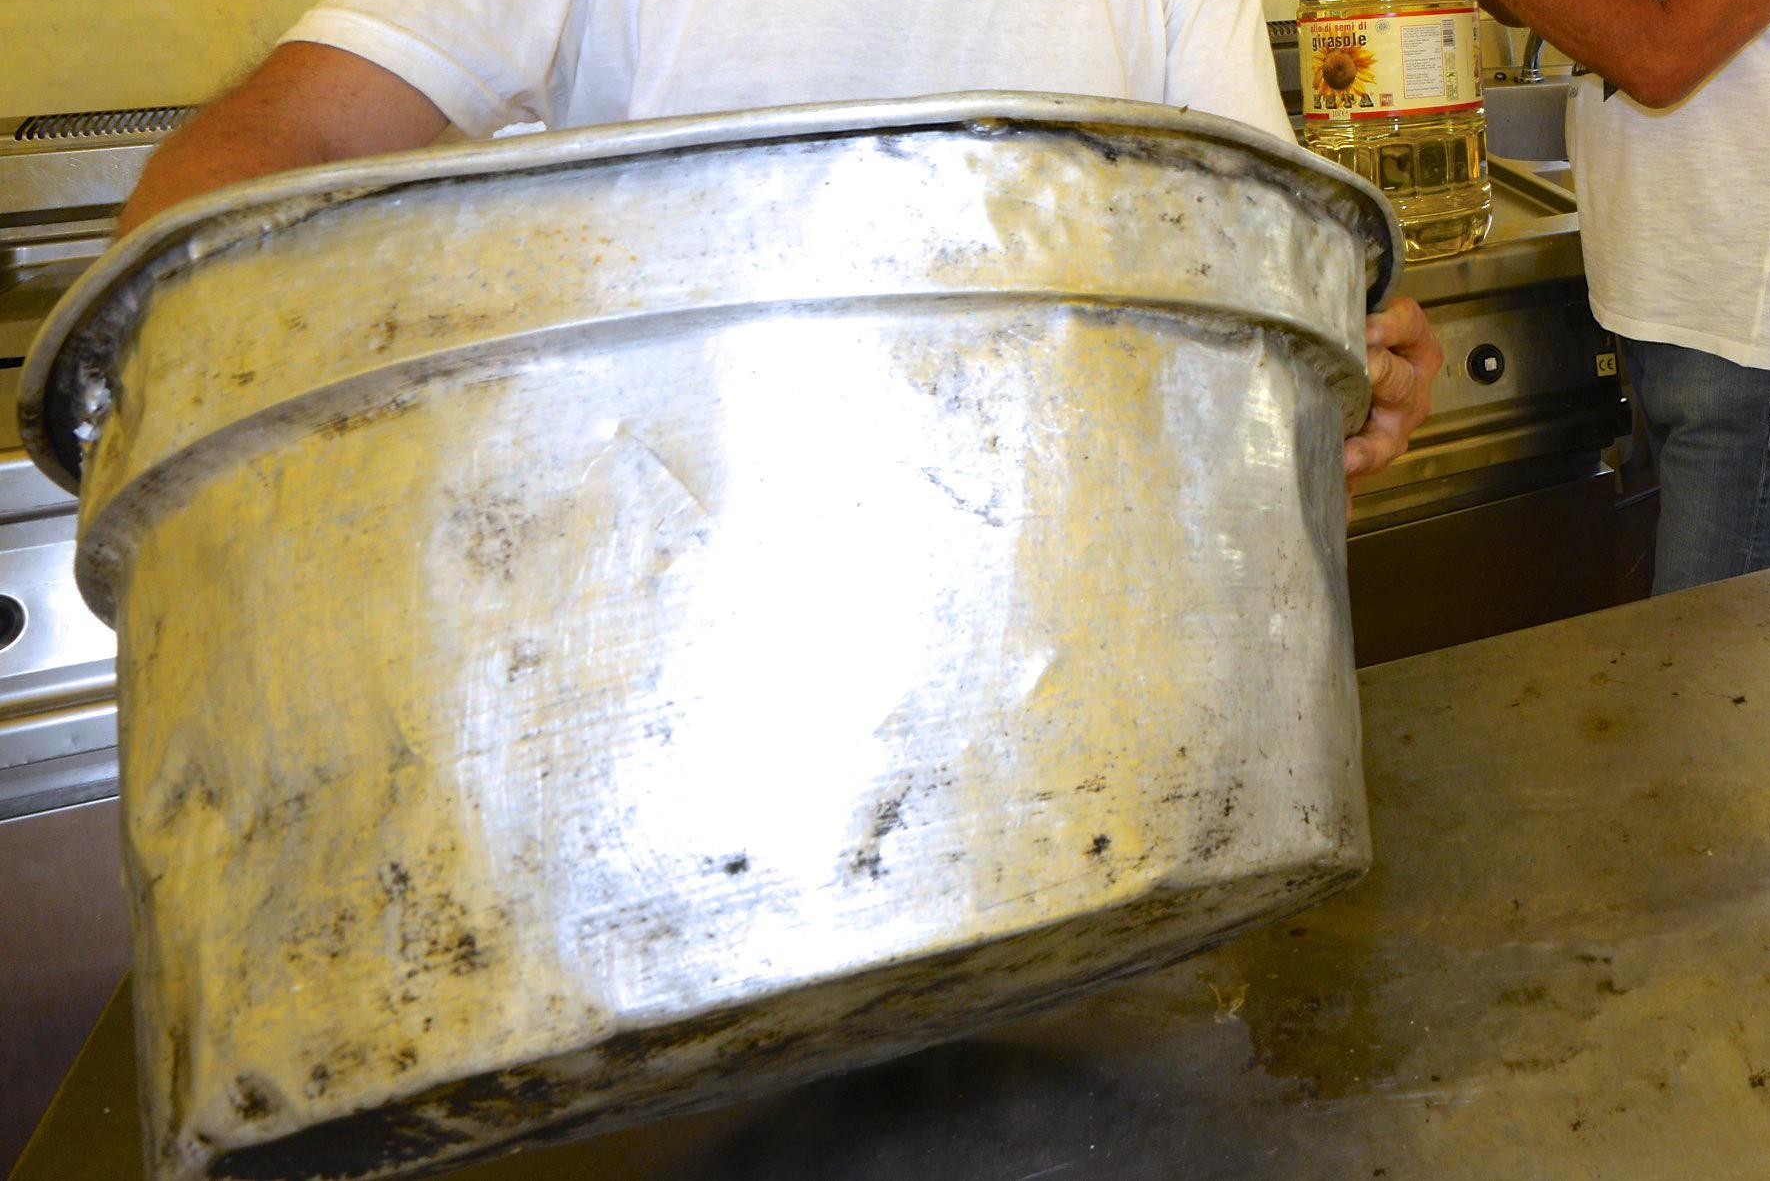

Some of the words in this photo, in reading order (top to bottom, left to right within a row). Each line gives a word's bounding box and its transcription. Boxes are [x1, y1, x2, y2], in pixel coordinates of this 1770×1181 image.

[1325, 22, 1332, 32] di
[1335, 22, 1355, 31] semi
[1359, 20, 1367, 30] di
[1312, 32, 1367, 51] girasole
